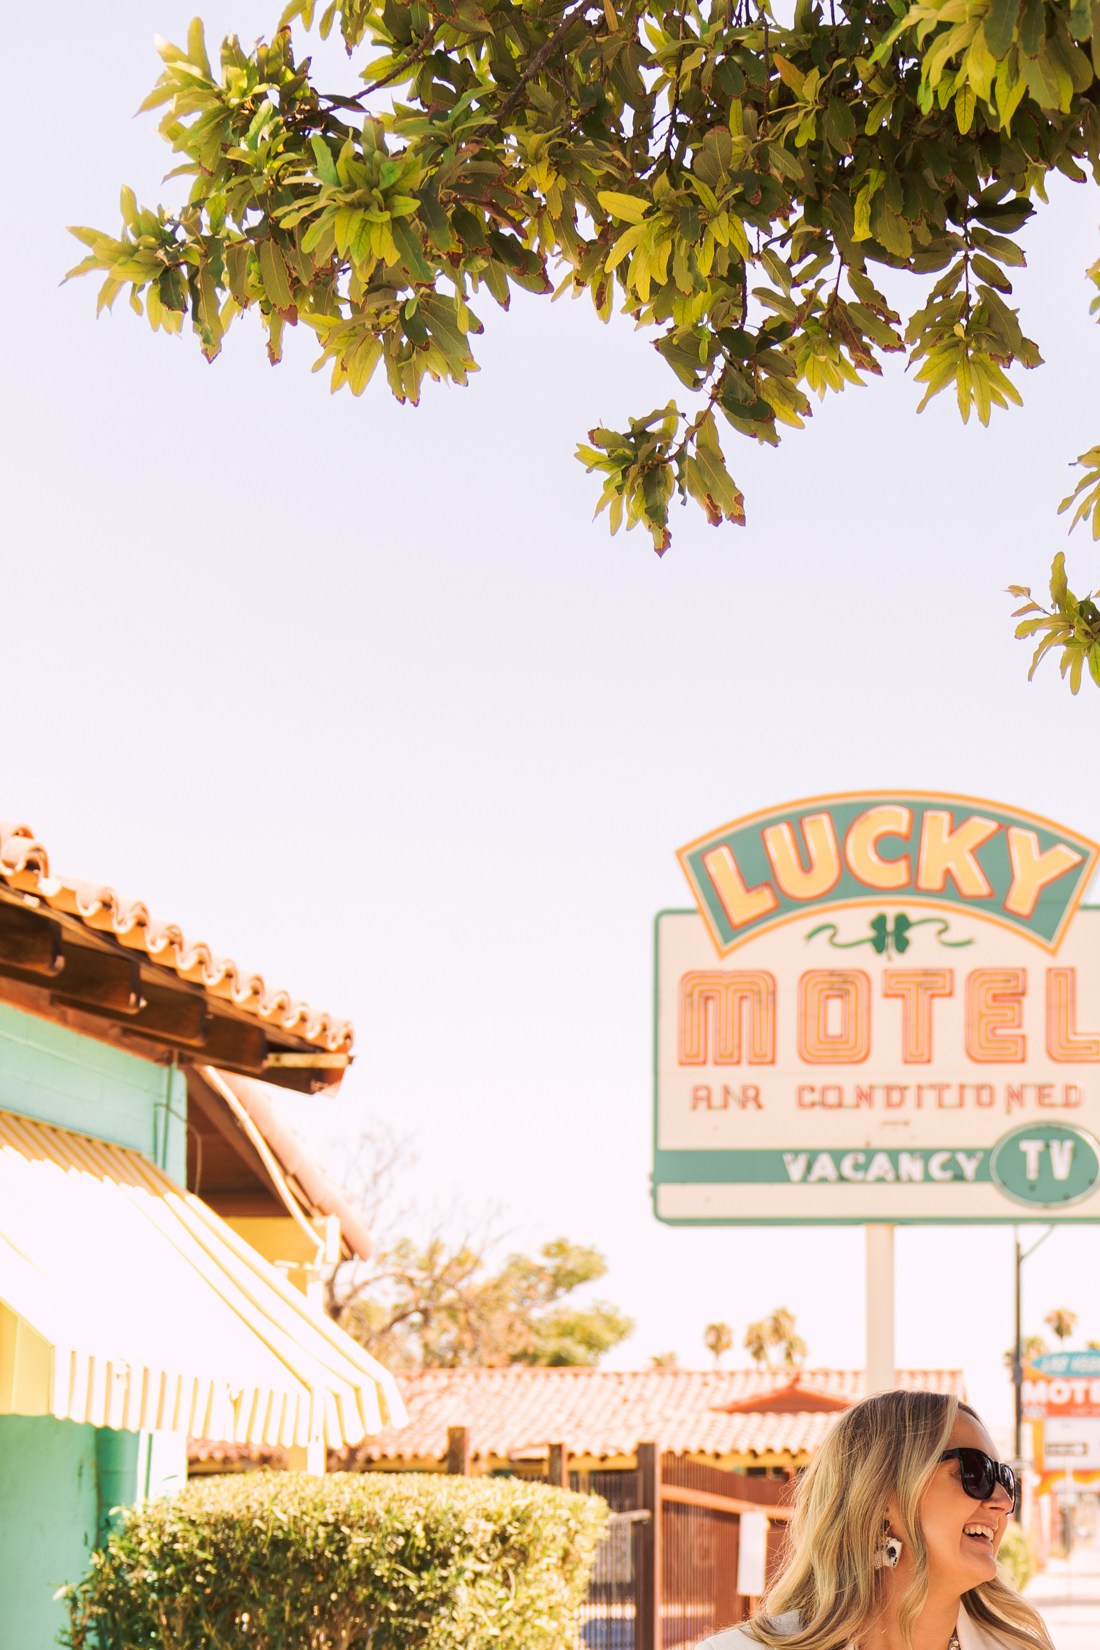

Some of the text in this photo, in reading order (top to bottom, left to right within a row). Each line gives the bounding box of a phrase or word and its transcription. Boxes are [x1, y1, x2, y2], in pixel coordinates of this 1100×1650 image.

[702, 803, 1086, 931] LUCKY
[691, 1083, 1084, 1111] AIR CONDITIONED
[782, 1139, 1076, 1181] VACANCY TV
